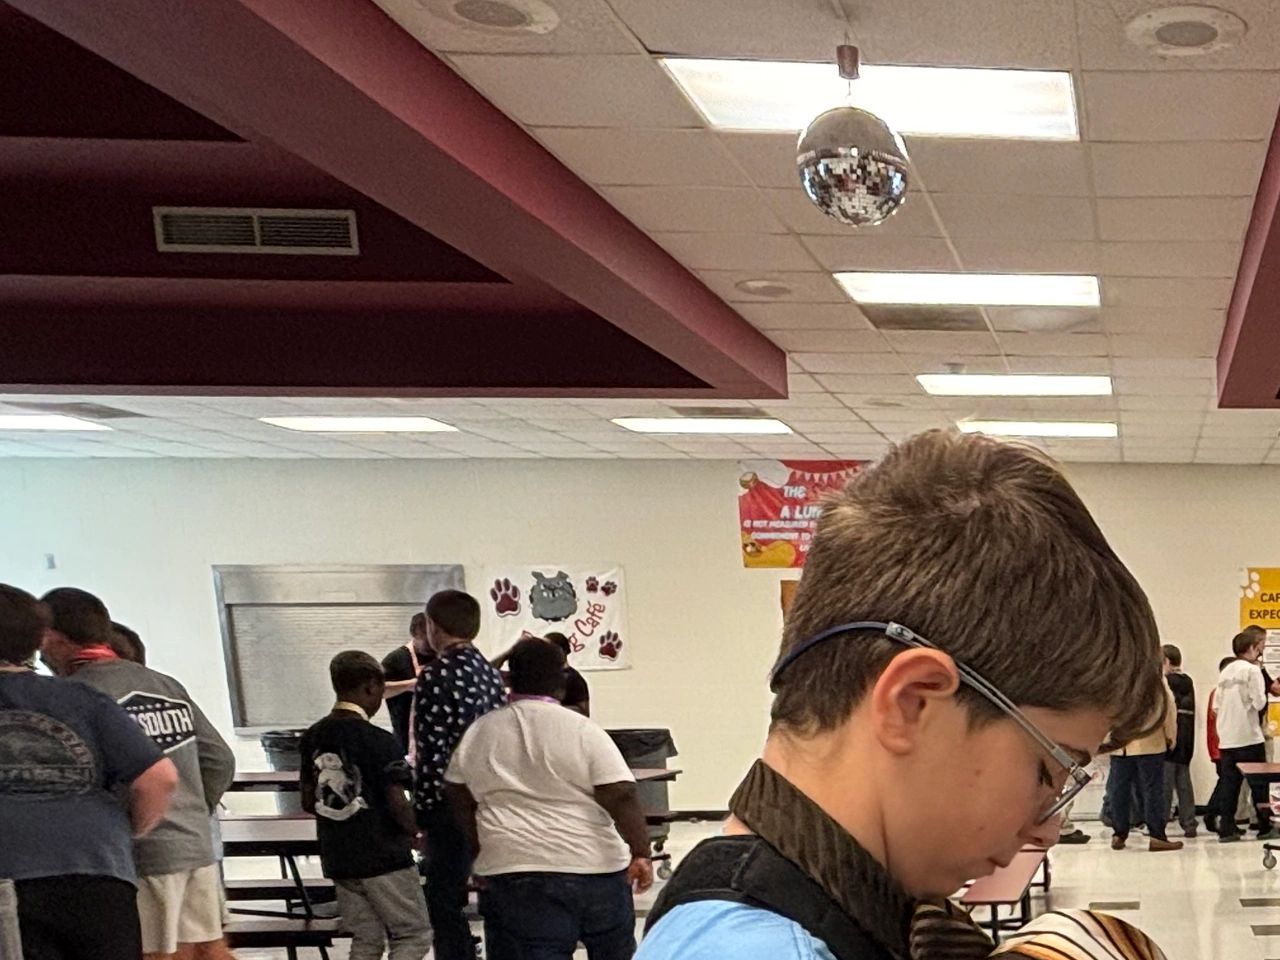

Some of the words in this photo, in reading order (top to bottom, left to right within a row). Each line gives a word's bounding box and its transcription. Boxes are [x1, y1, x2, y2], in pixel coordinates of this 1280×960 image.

[784, 486, 806, 498] THE
[780, 505, 791, 519] A
[794, 505, 822, 519] LUN
[574, 600, 606, 637] Café
[137, 708, 194, 737] SOUTH
